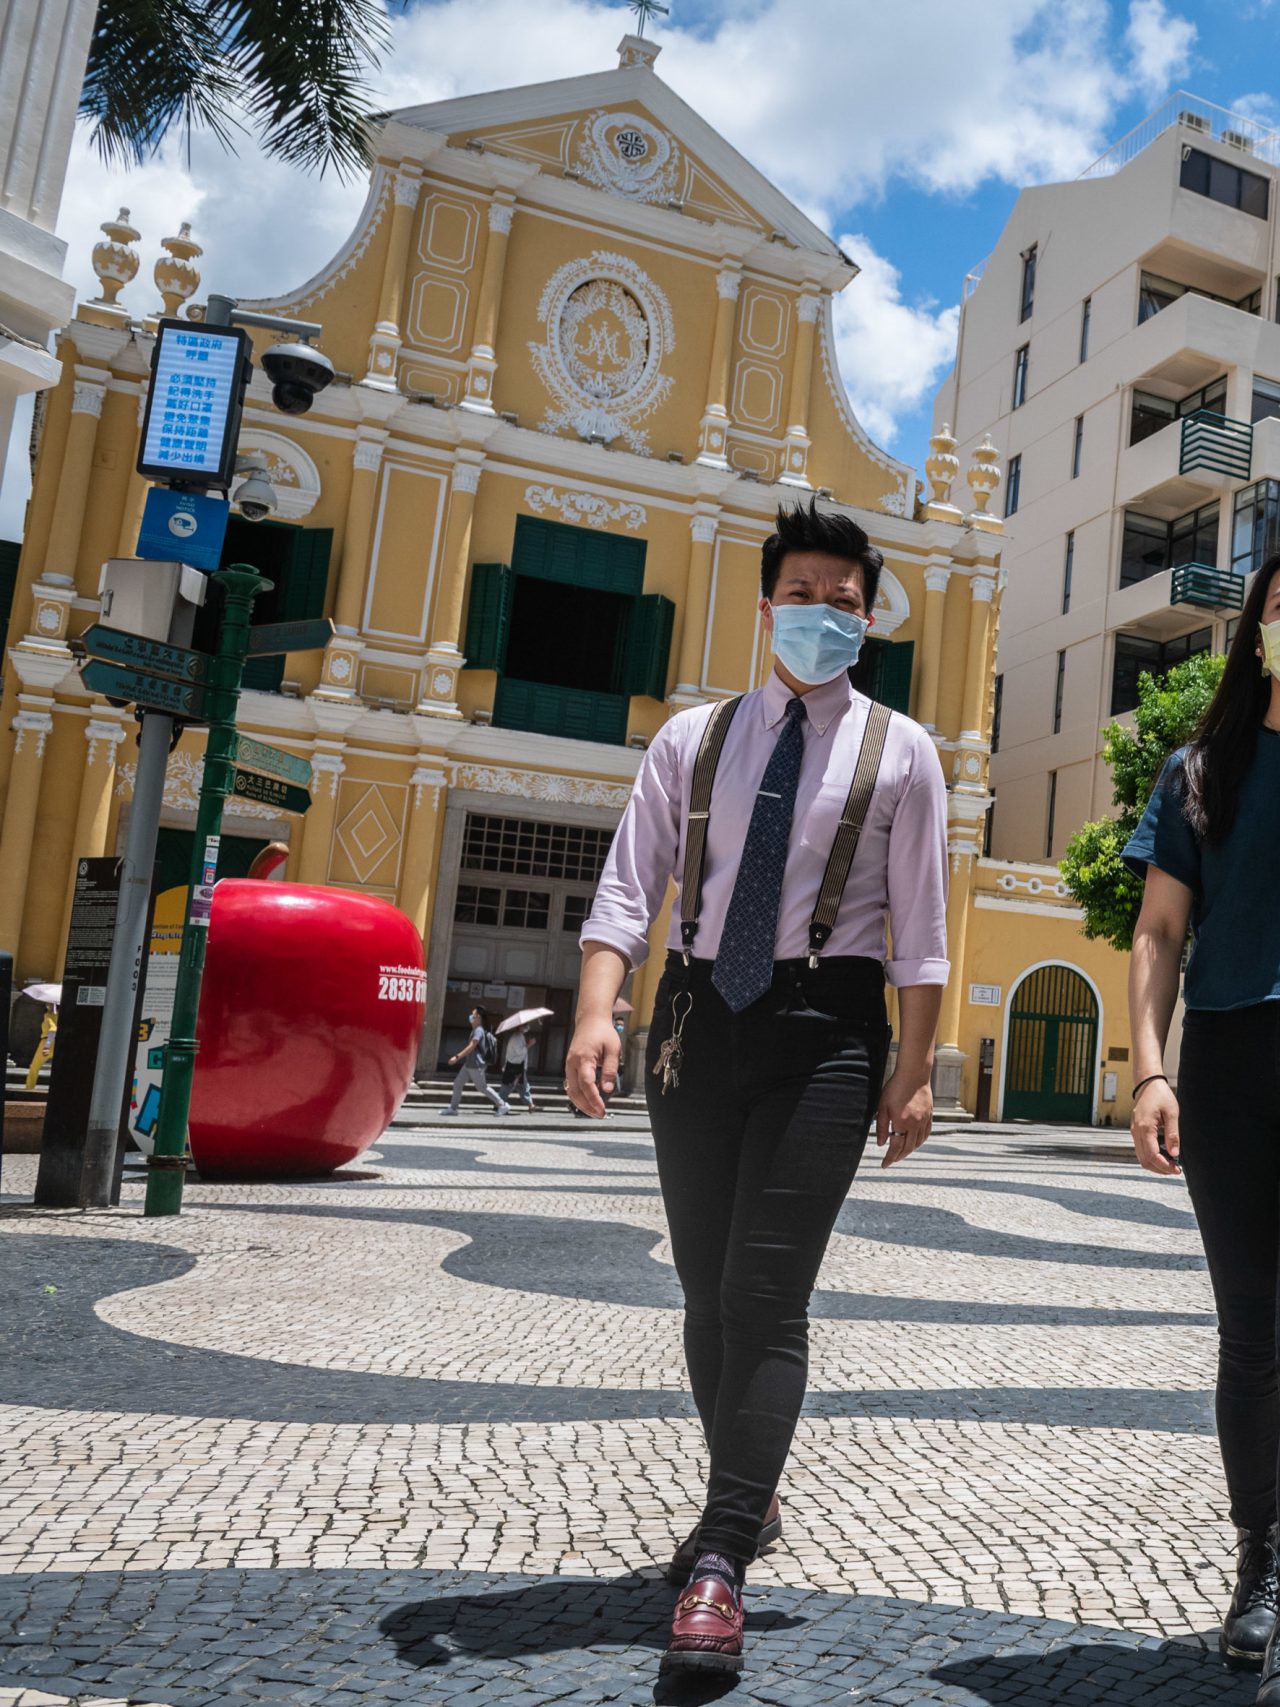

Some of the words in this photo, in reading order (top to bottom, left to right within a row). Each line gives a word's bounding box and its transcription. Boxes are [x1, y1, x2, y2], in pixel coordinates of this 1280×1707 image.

[169, 373, 216, 388] 必須堅持
[168, 386, 216, 400] 記得洗手
[166, 398, 213, 413] 戴好口罩
[162, 424, 209, 438] 保持距離
[160, 437, 207, 451] 健康聲明
[157, 450, 205, 464] 減少出境
[378, 976, 414, 1002] 2833
